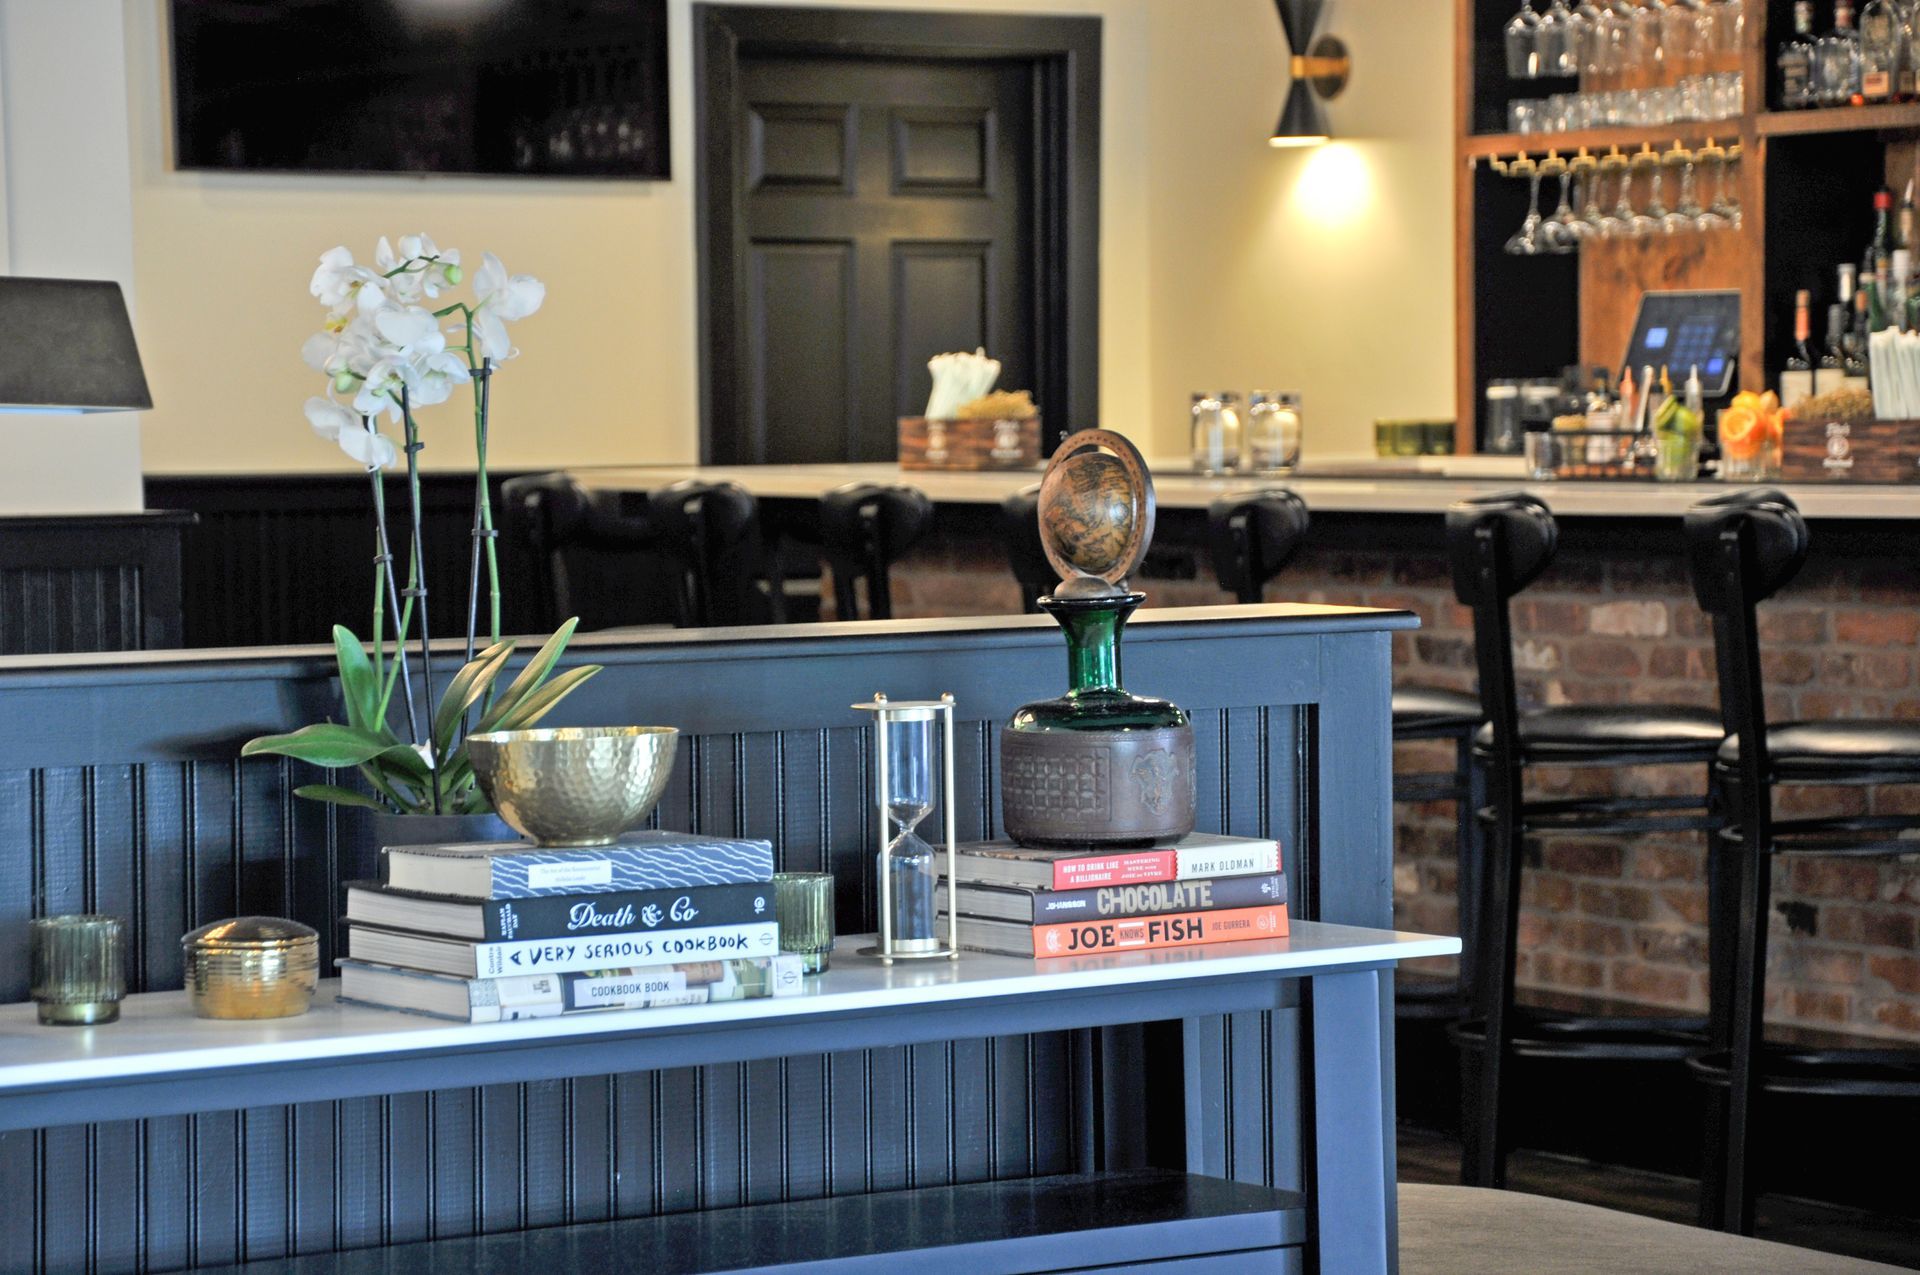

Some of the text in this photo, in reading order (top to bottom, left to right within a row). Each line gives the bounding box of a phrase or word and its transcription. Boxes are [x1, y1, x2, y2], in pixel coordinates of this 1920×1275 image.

[1063, 861, 1120, 874] HOW TO DRINK LIKE
[1191, 862, 1216, 873] MARK
[1219, 858, 1255, 871] OLDMAN
[1076, 872, 1112, 883] BILLIONAIRE
[1097, 880, 1214, 915] CHOCOLATE
[567, 896, 699, 931] Death & Co
[1068, 917, 1203, 950] JOE KNOWS FISH
[1212, 921, 1222, 931] JOE
[509, 933, 749, 966] A VERY SERIOUS COOKBOOK
[591, 981, 670, 998] COOKBOOK BOOK
